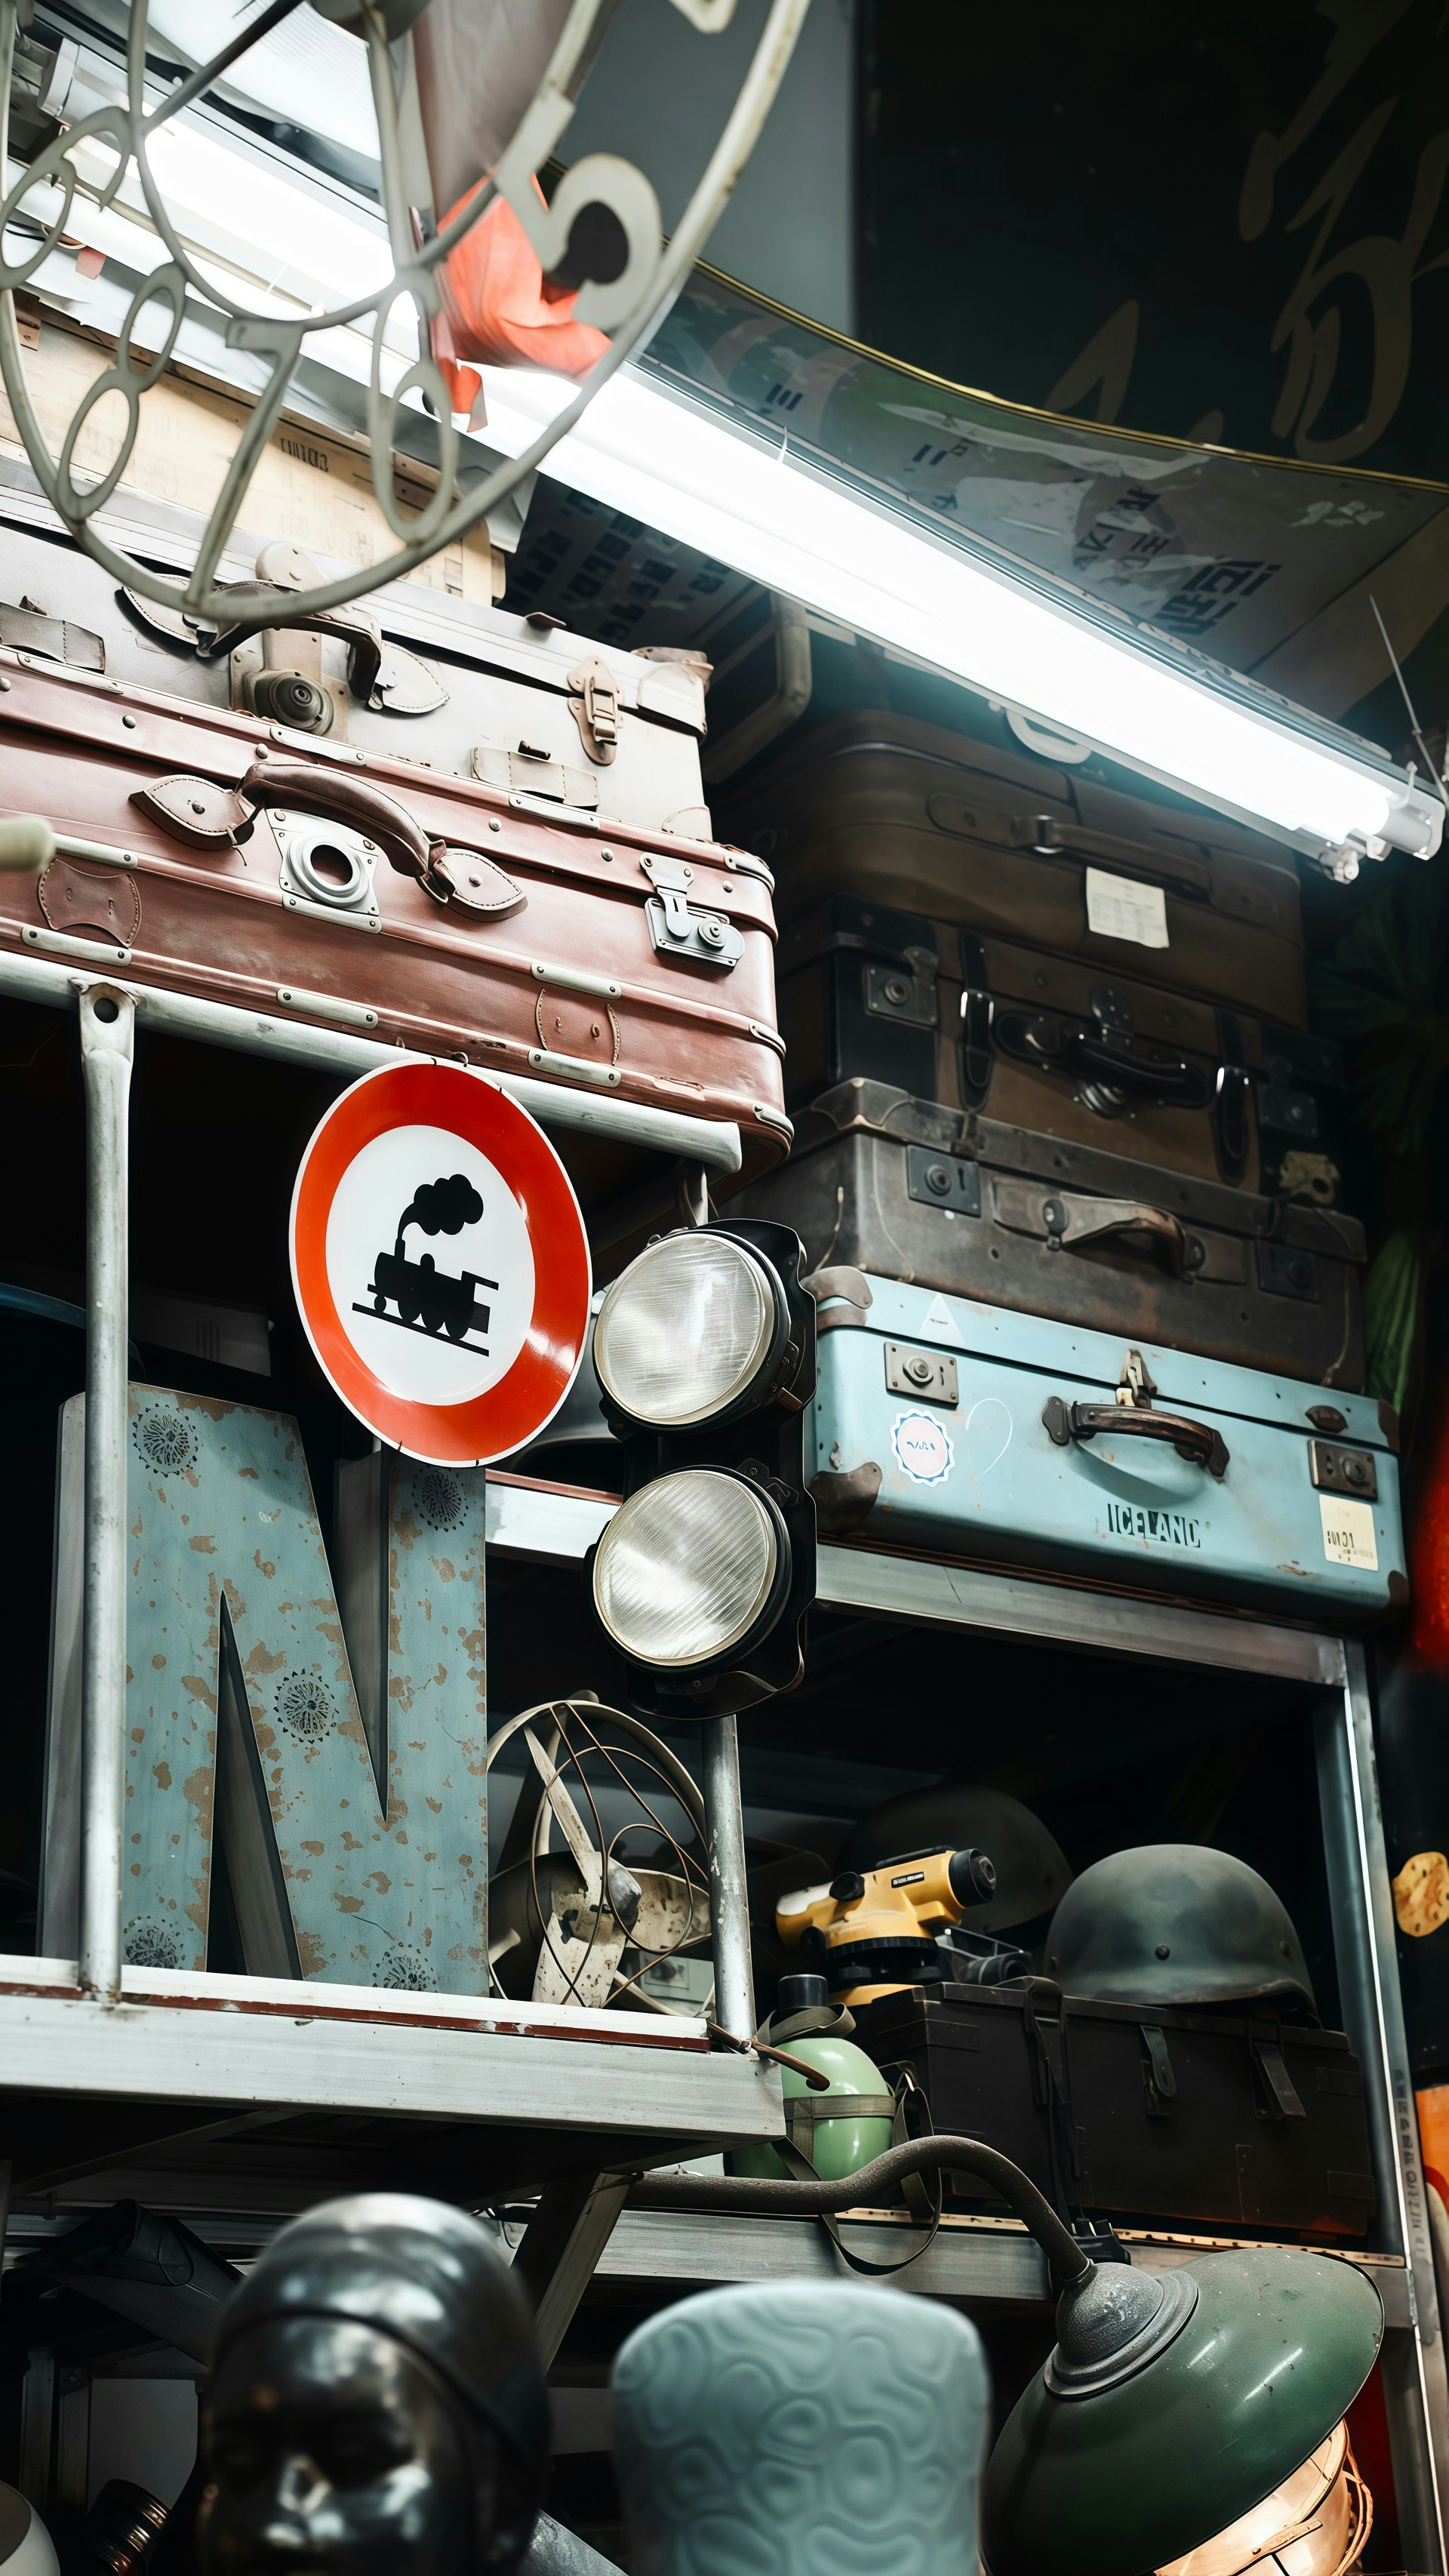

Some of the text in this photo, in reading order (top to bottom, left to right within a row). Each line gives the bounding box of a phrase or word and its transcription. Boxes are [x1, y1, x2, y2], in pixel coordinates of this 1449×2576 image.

[0, 106, 131, 290] 9
[496, 92, 663, 331] 5
[58, 261, 187, 521] 8
[185, 315, 304, 604] 7
[368, 269, 459, 546] 6
[1107, 1503, 1201, 1549] ICELAND
[121, 1383, 489, 1997] N
